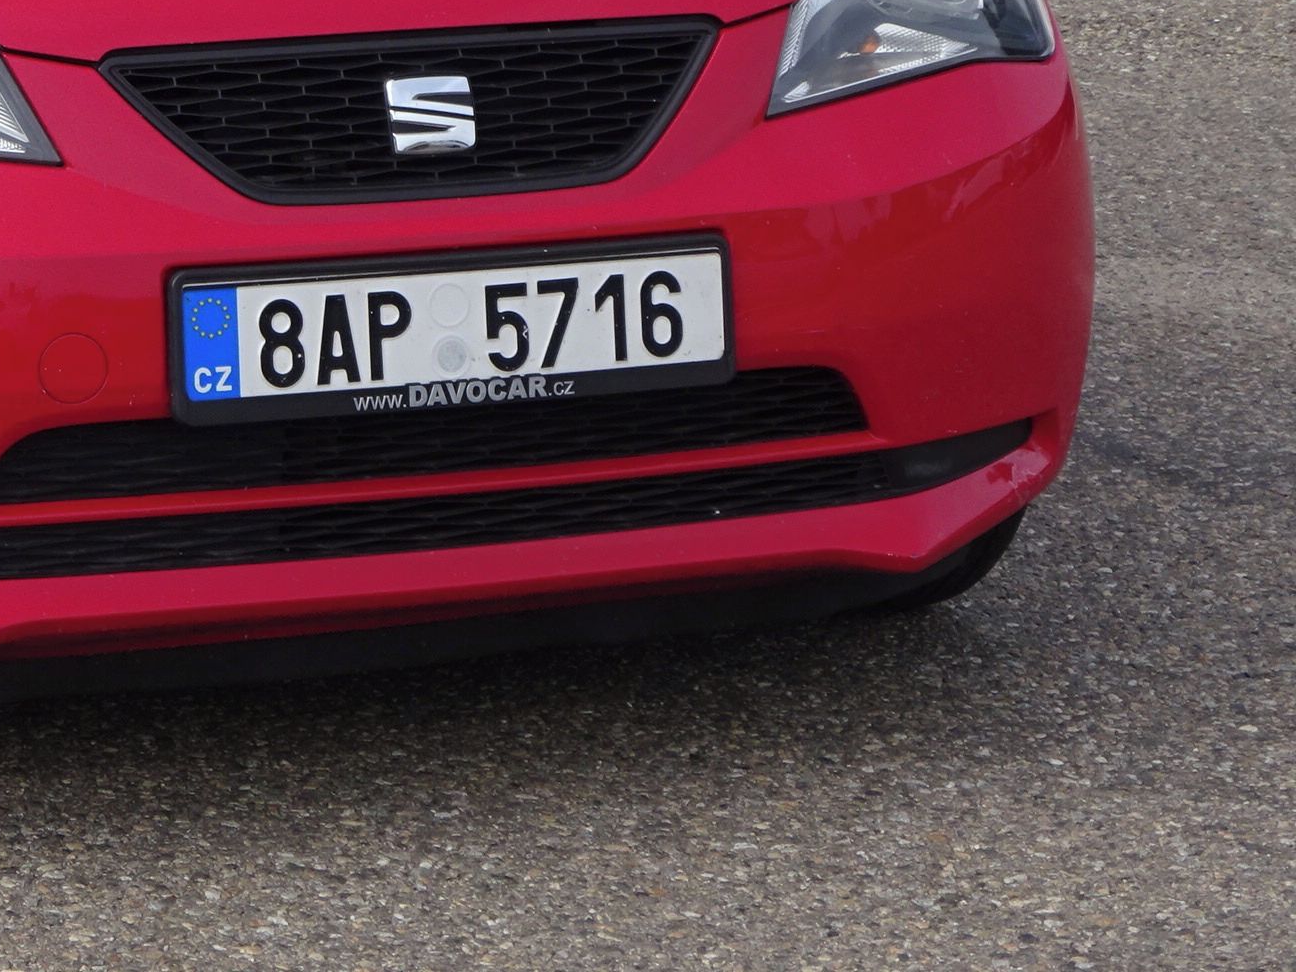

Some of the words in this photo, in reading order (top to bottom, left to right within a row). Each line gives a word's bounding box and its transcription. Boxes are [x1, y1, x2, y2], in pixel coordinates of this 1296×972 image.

[258, 290, 412, 389] 8AP
[484, 270, 684, 372] 5716
[193, 365, 233, 394] CZ
